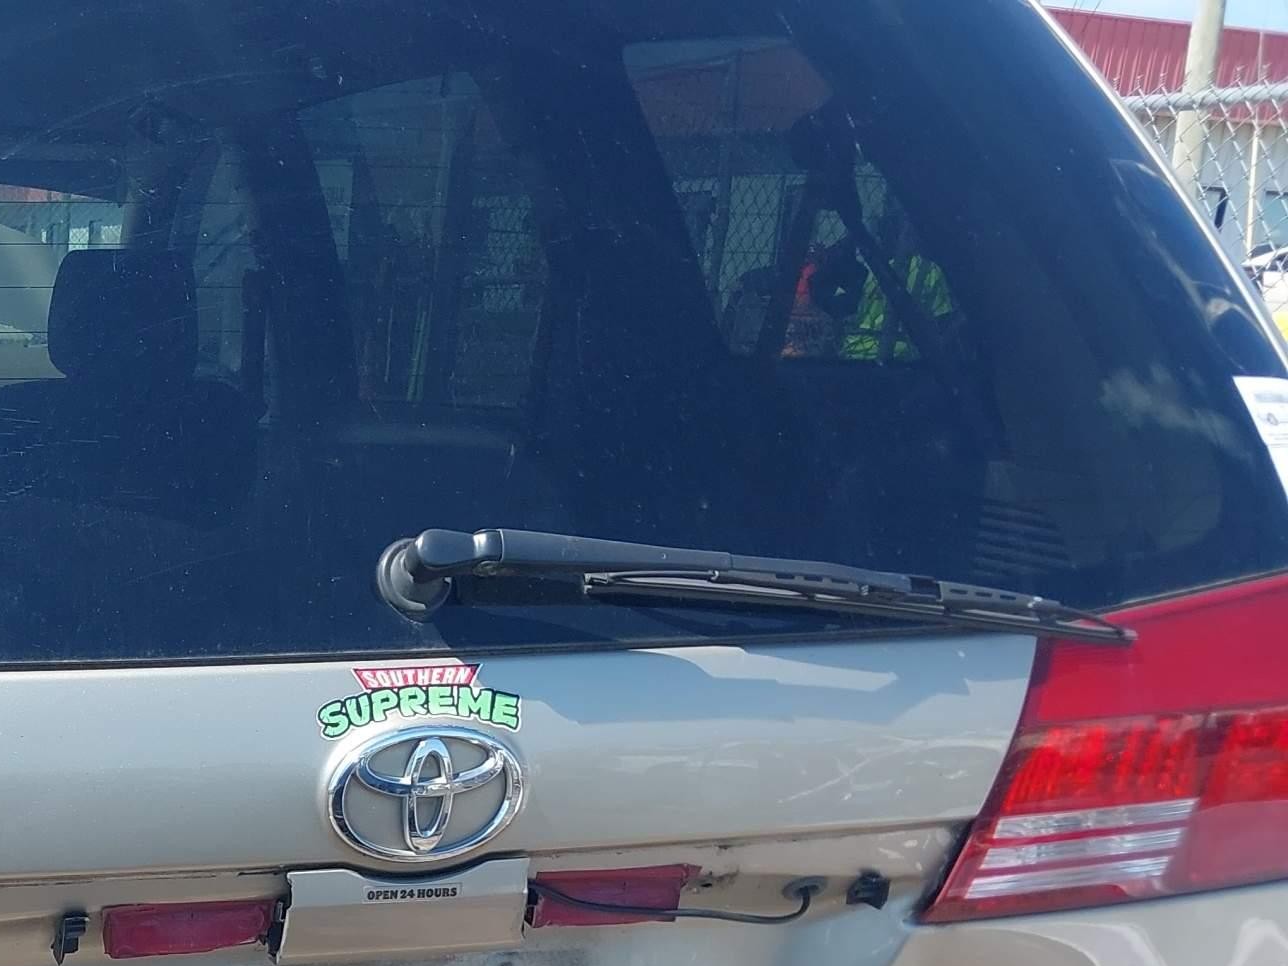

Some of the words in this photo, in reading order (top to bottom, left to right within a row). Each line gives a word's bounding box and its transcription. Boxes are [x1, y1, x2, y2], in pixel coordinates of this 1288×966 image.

[361, 667, 471, 688] SOUTHERN
[318, 684, 521, 738] SUPREME
[367, 890, 399, 900] OPEN
[400, 889, 416, 899] 24
[417, 887, 457, 898] HOURS
